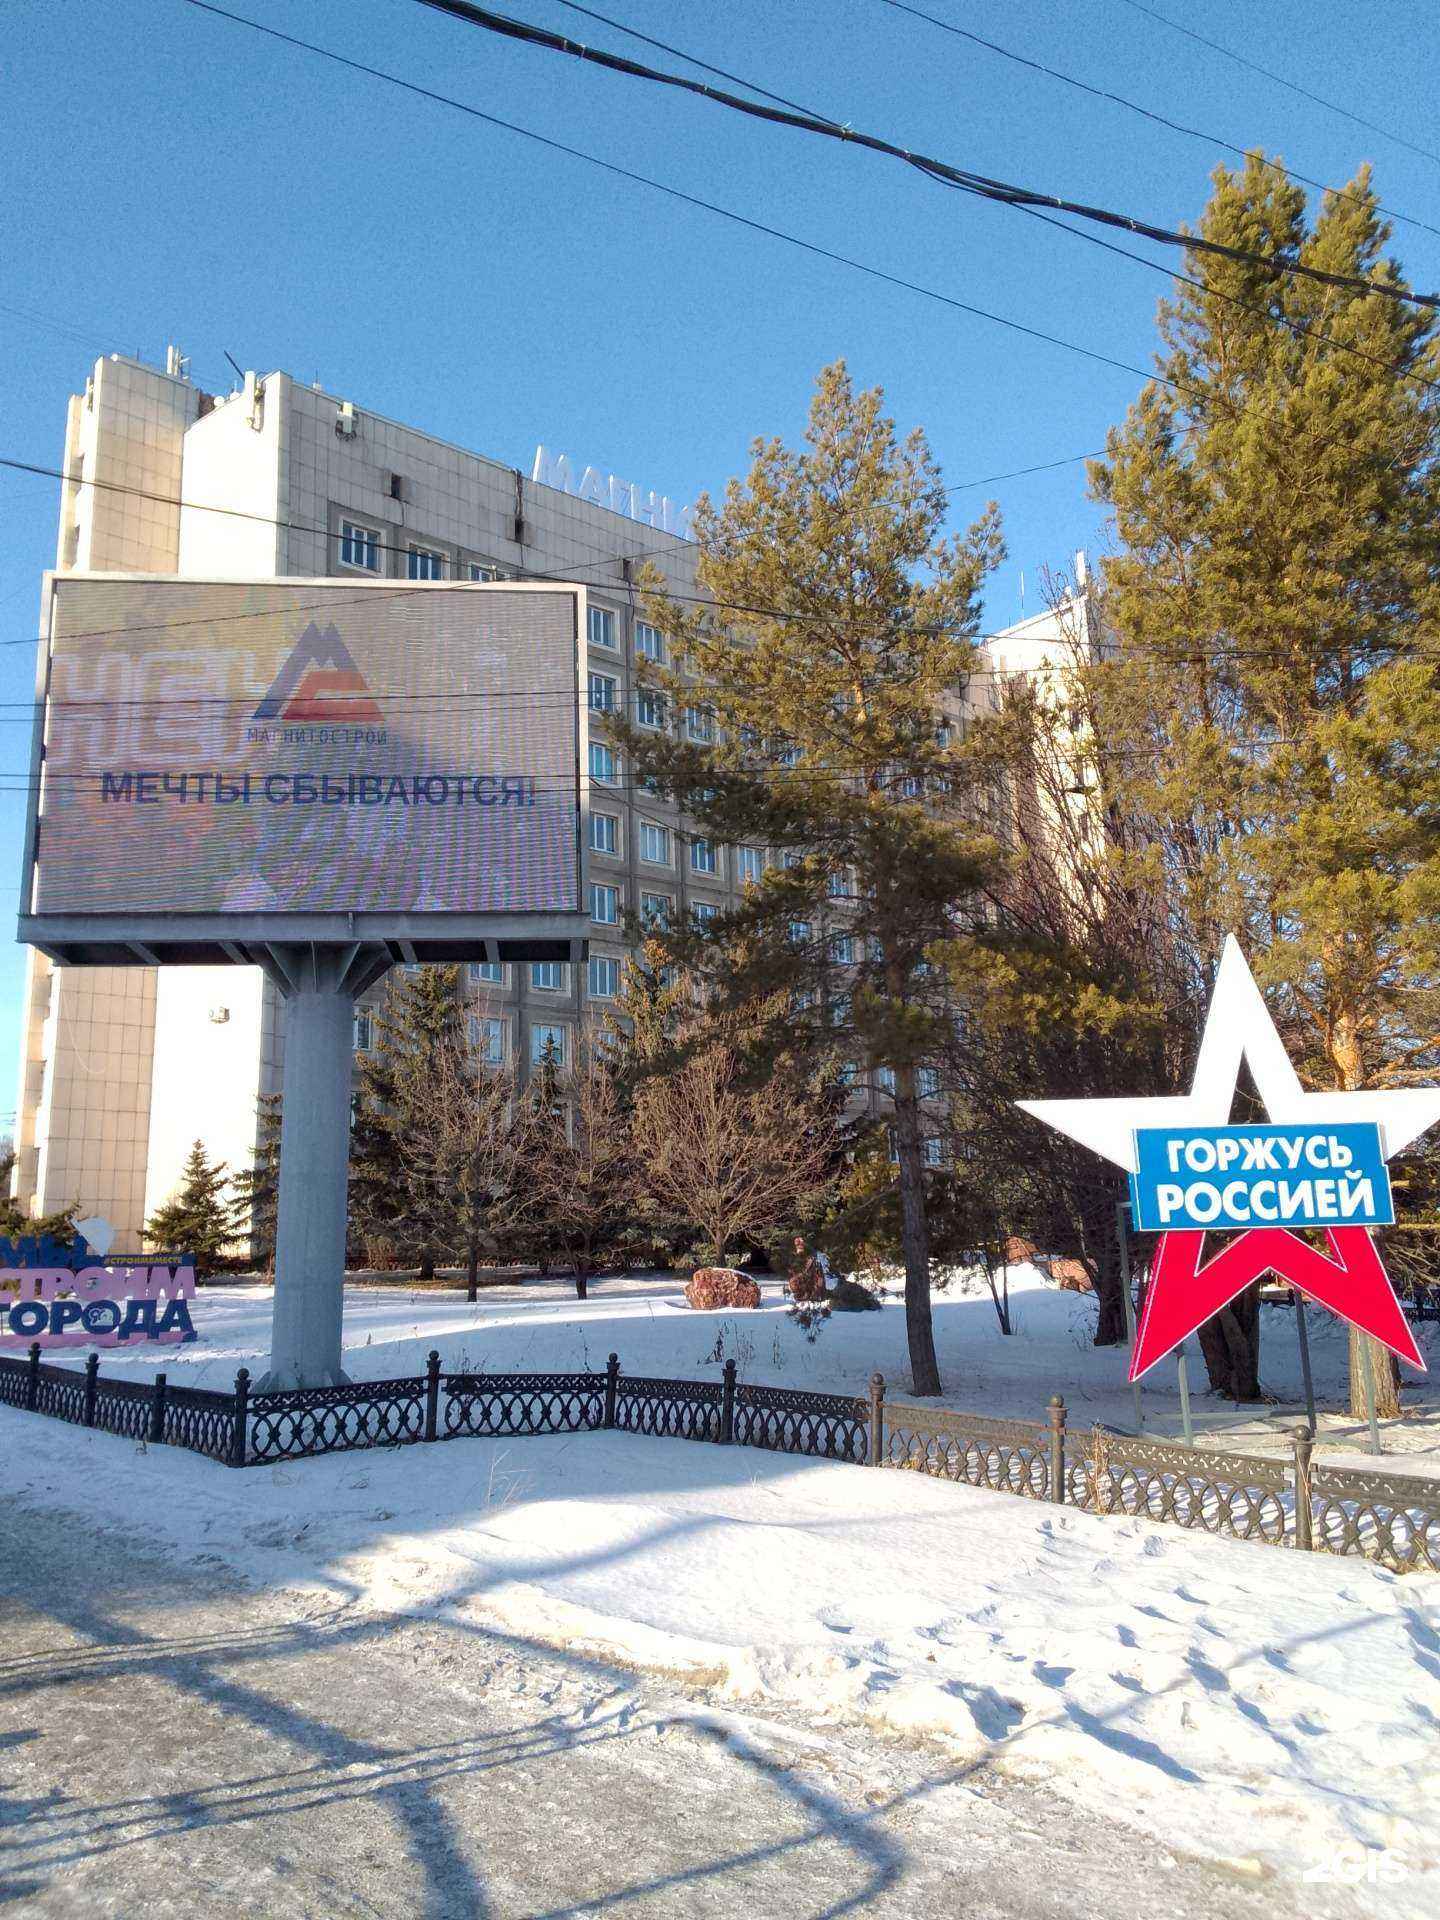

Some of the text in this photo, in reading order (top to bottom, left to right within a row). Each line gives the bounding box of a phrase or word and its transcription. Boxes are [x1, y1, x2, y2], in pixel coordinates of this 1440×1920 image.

[101, 771, 536, 807] МЕЧТЫ СБЫВАЮТСЯ!
[1167, 1135, 1353, 1172] ГОРЖУСЬ
[1157, 1169, 1376, 1223] РОССИЕЙ
